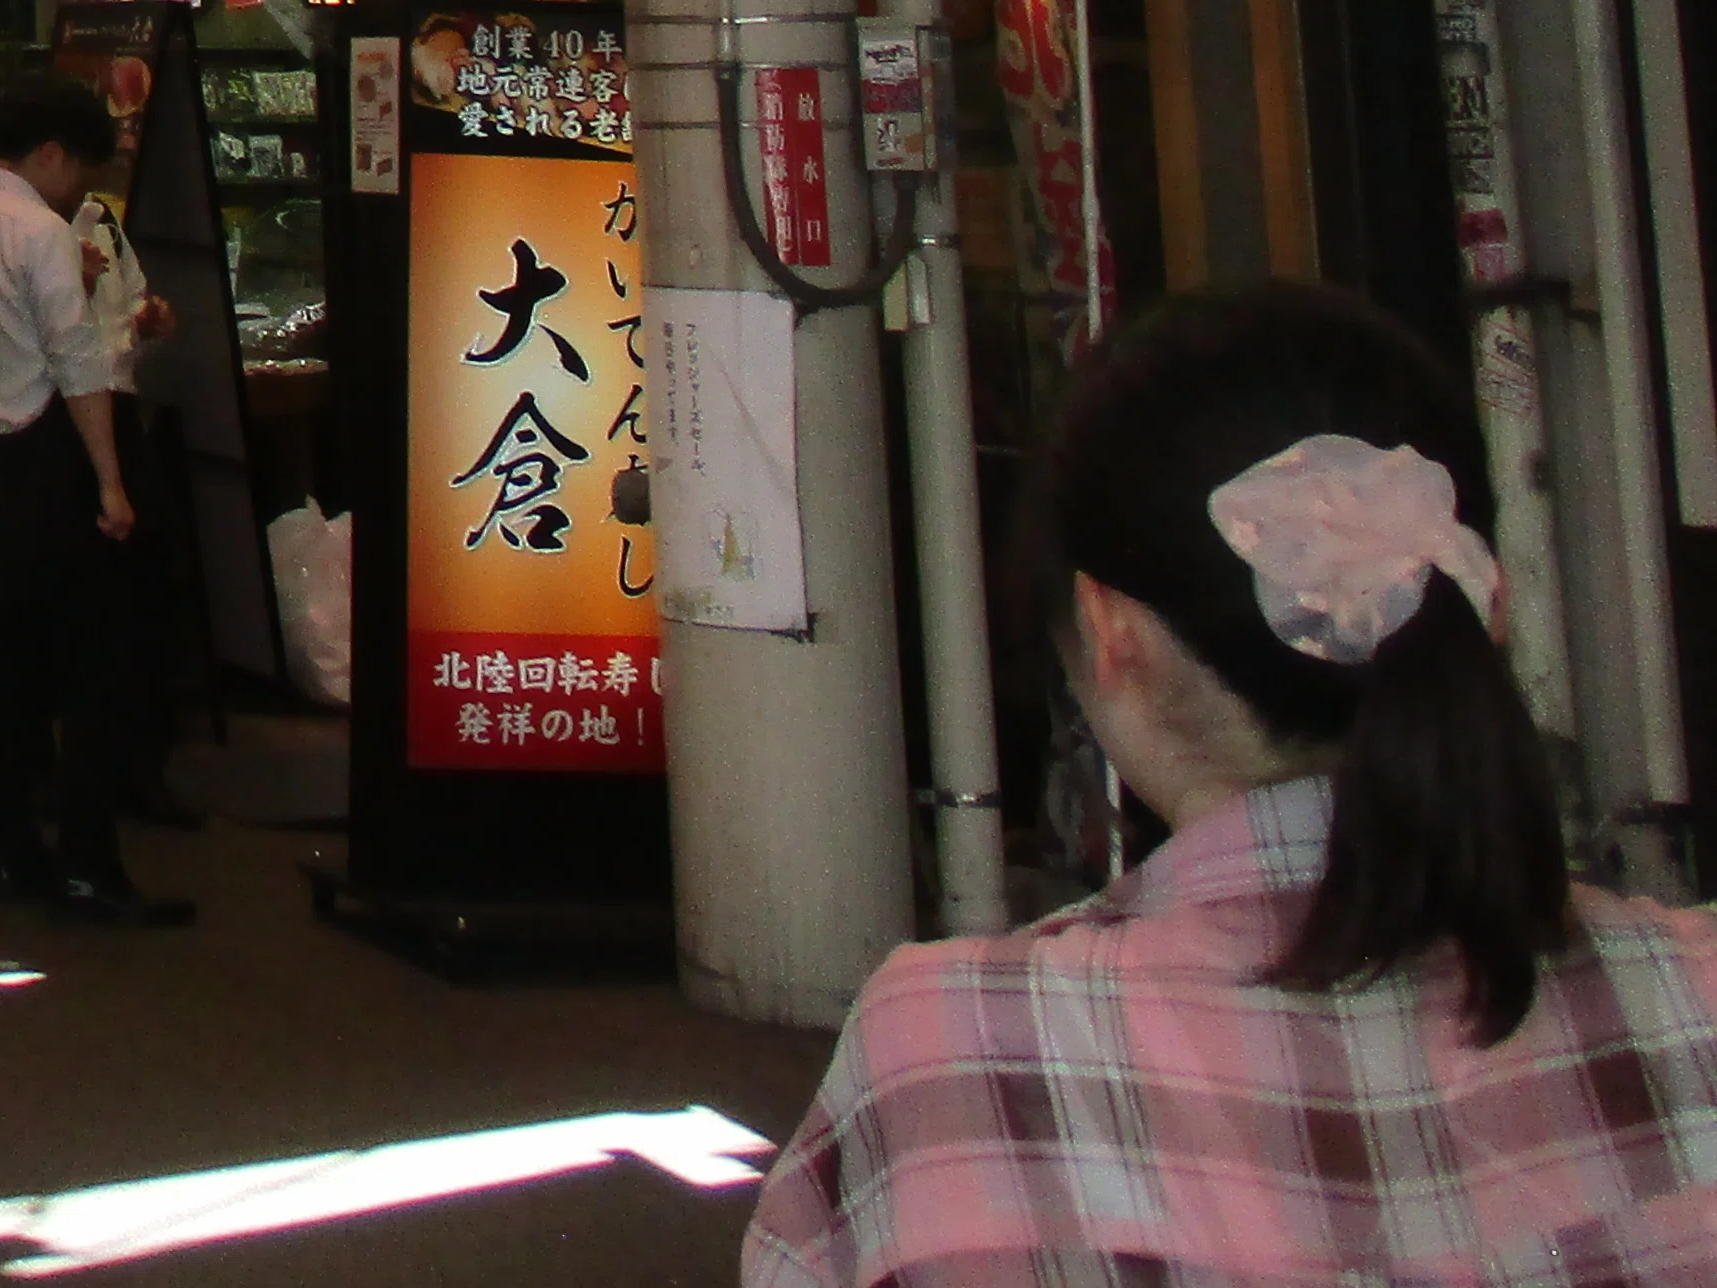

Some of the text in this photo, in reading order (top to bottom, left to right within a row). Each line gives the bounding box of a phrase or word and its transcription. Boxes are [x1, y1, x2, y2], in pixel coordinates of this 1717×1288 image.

[471, 23, 623, 64] 創業40年
[450, 236, 592, 554] 大倉
